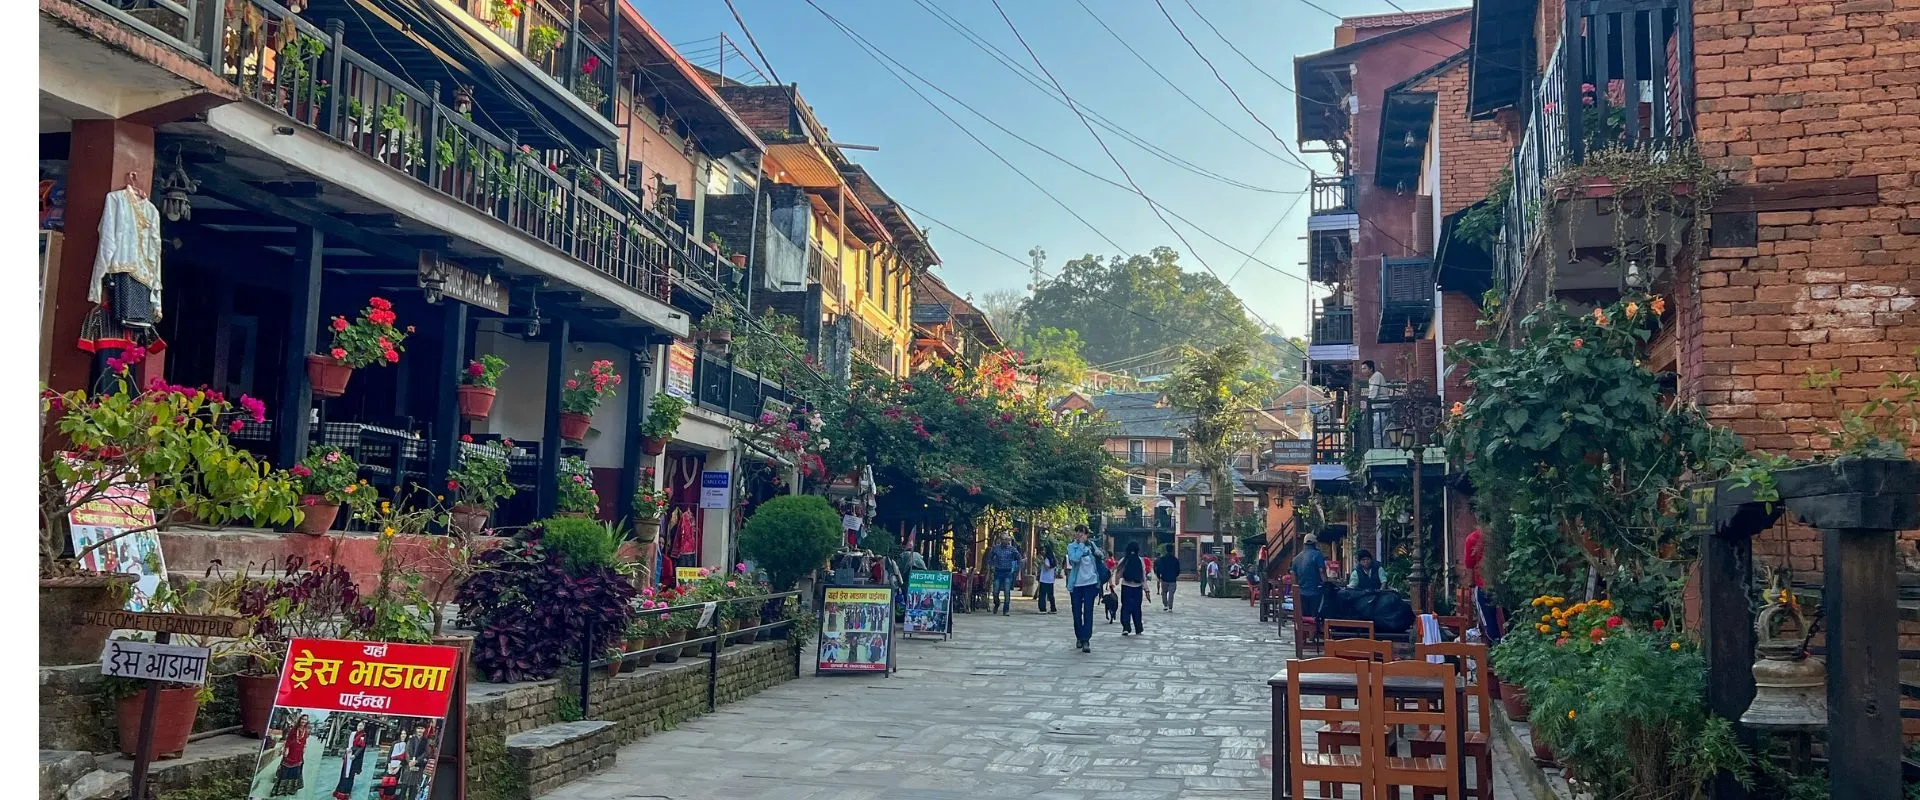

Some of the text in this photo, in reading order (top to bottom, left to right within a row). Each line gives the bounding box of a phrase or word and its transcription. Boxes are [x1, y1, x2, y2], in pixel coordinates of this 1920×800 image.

[86, 612, 234, 637] WELCOME TO BANDIPUR
[109, 643, 206, 681] ड्रेस भाडामा
[290, 649, 450, 691] ड्रेस भाडामा
